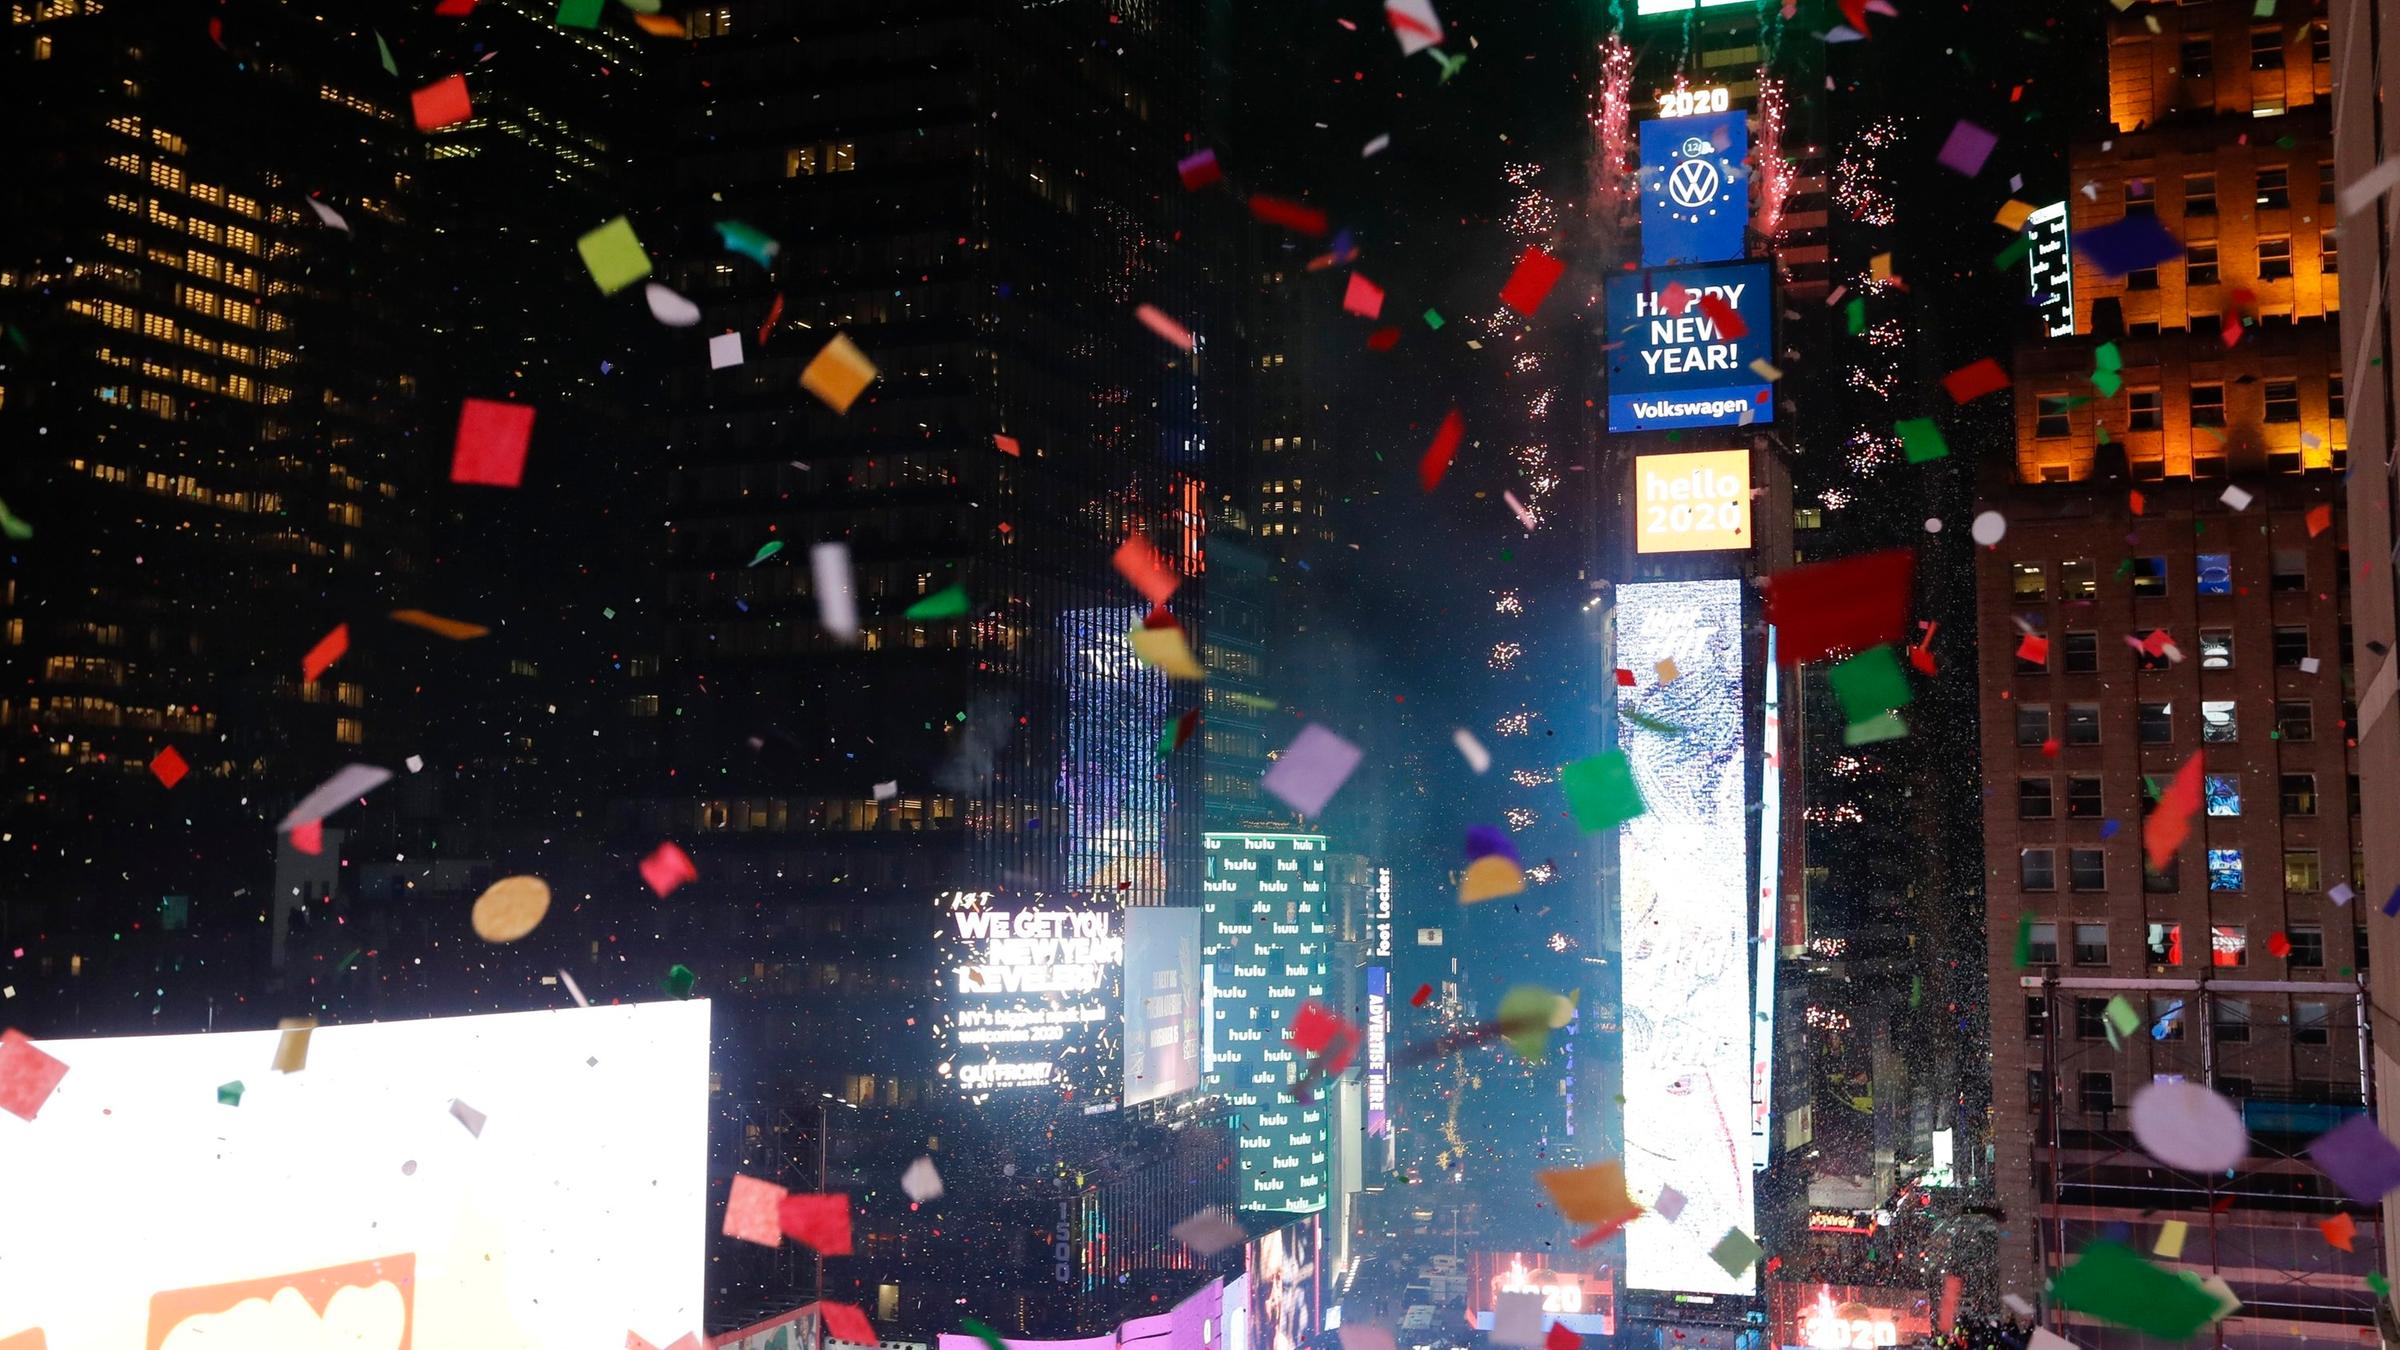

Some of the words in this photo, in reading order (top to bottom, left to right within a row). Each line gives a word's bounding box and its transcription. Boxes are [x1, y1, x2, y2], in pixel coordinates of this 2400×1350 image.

[1660, 88, 1728, 118] 2020
[1687, 143, 1699, 152] 12
[1653, 182, 1660, 191] 9
[1727, 175, 1735, 184] 3
[1690, 215, 1698, 224] 6
[1637, 284, 1745, 317] HPPY
[1641, 344, 1738, 374] YEAR!
[1633, 398, 1748, 419] Volkswagen
[1645, 468, 1740, 502] hello
[1647, 502, 1741, 532] 2020
[1245, 838, 1275, 849] hulu
[1293, 839, 1313, 850] hulu
[1224, 858, 1256, 870] hulu
[1204, 880, 1236, 892] hulu
[1259, 880, 1288, 892] hulu
[1376, 867, 1391, 919] Locker
[955, 911, 1010, 938] WE
[1013, 911, 1065, 938] GET
[1068, 911, 1109, 938] YOU
[1376, 923, 1391, 957] Foot
[990, 938, 1059, 965] NEW
[1234, 965, 1266, 976] hulu
[1286, 964, 1308, 976] hulu
[1214, 986, 1247, 998] hulu
[1269, 985, 1296, 998] hulu
[1030, 1026, 1063, 1041] 2020
[1229, 1028, 1261, 1041] hulu
[1368, 994, 1384, 1070] ADVERTISE
[1264, 1049, 1292, 1062] hulu
[1369, 1074, 1384, 1111] HERE
[1259, 1113, 1288, 1126] hulu
[1240, 1136, 1271, 1148] hulu
[1289, 1133, 1312, 1146] hulu
[1273, 1156, 1299, 1169] hulu
[1254, 1178, 1284, 1191] hulu
[1055, 1202, 1070, 1281] 1500
[1502, 1285, 1582, 1312] 20
[1806, 1319, 1896, 1349] 2020
